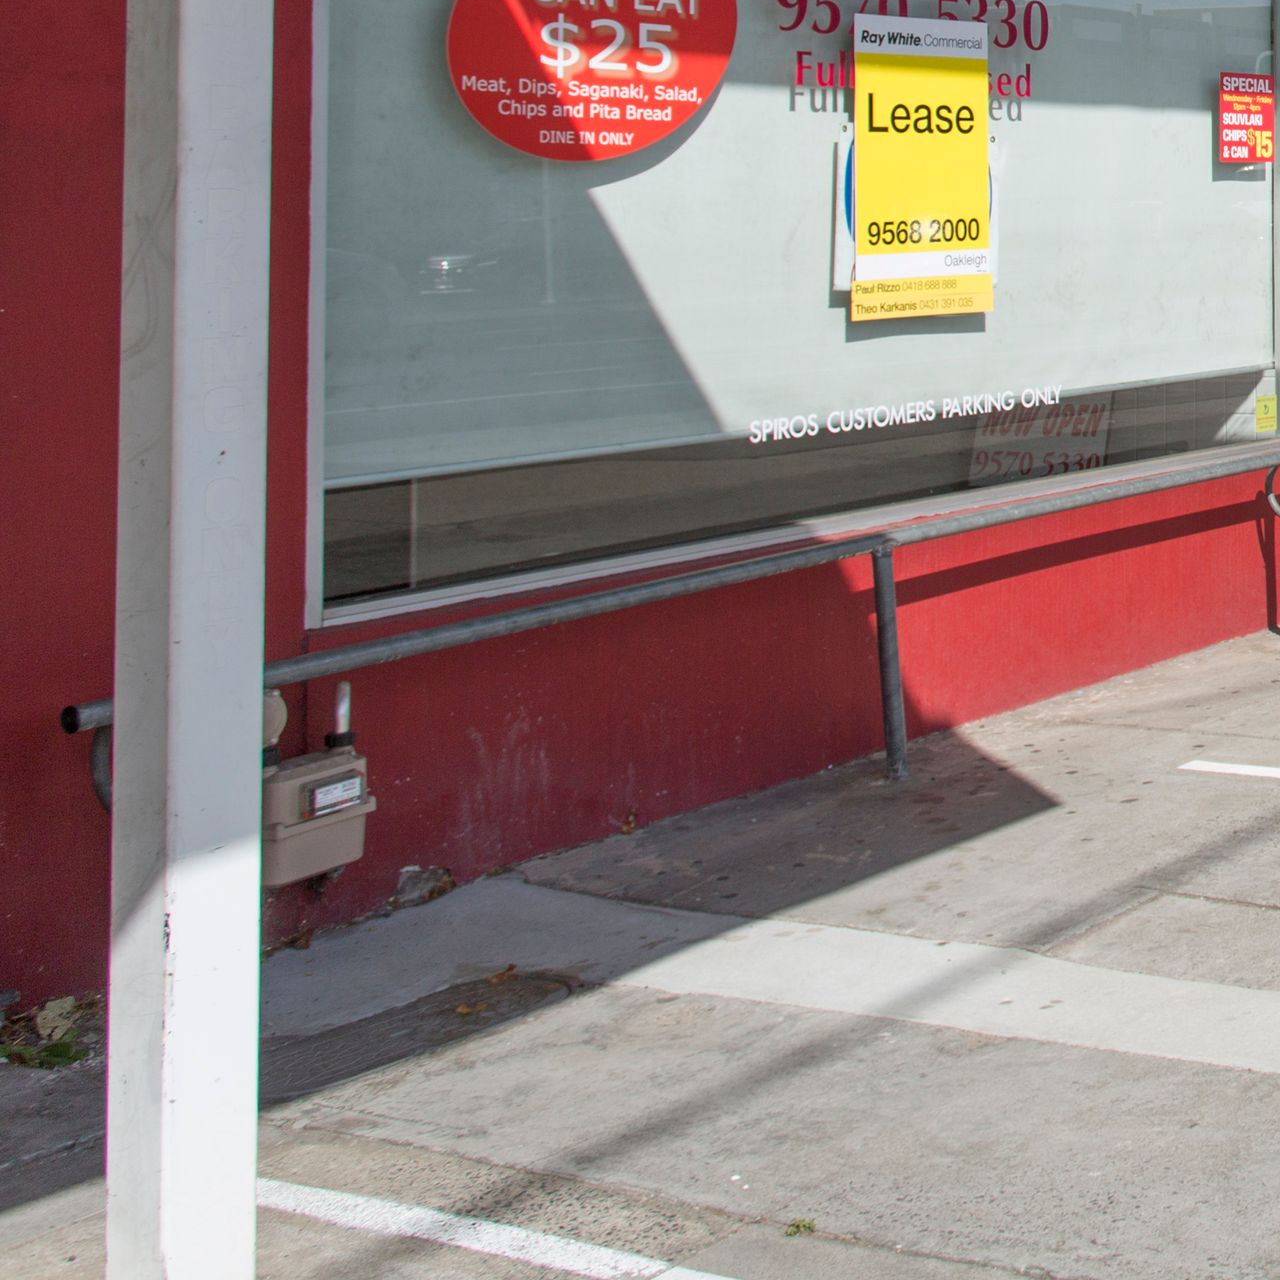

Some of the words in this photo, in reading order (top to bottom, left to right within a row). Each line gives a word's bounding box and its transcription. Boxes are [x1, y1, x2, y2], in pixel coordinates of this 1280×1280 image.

[539, 12, 674, 78] $25
[861, 29, 886, 47] Ray
[923, 33, 983, 50] Commercial
[795, 50, 855, 88] Full
[461, 75, 511, 94] Meat,
[518, 78, 562, 98] Dips,
[568, 81, 649, 102] Saganaki,
[654, 85, 703, 105] Salad,
[1222, 76, 1273, 93] SPECIAL
[498, 98, 547, 119] Chips
[552, 100, 584, 118] and
[589, 103, 621, 120] Pita
[626, 106, 673, 122] Bread
[1222, 93, 1253, 103] Wednesday
[1256, 95, 1273, 104] Friday
[868, 92, 975, 134] Lease
[1222, 112, 1263, 126] SOUVLAKI
[539, 129, 575, 144] DINE
[580, 130, 595, 144] IN
[599, 131, 635, 146] ONLY
[1222, 128, 1248, 142] CHIPS
[1247, 127, 1273, 159] $15
[1222, 145, 1230, 159] &
[1230, 146, 1249, 159] CAN
[867, 220, 922, 246] 9568
[928, 217, 980, 243] 2000
[944, 254, 988, 268] Oakleigh
[855, 283, 875, 295] Paul
[876, 283, 901, 293] Rizzo
[855, 303, 878, 315] Theo
[879, 301, 918, 313] Karkanis
[749, 414, 820, 445] SPIROS
[826, 399, 937, 435] CUSTOMERS
[941, 386, 1016, 420] PARKING
[1020, 383, 1063, 409] ONLY
[1041, 402, 1107, 437] OPEN
[972, 450, 1034, 480] 9570
[1038, 450, 1103, 478] 5330
